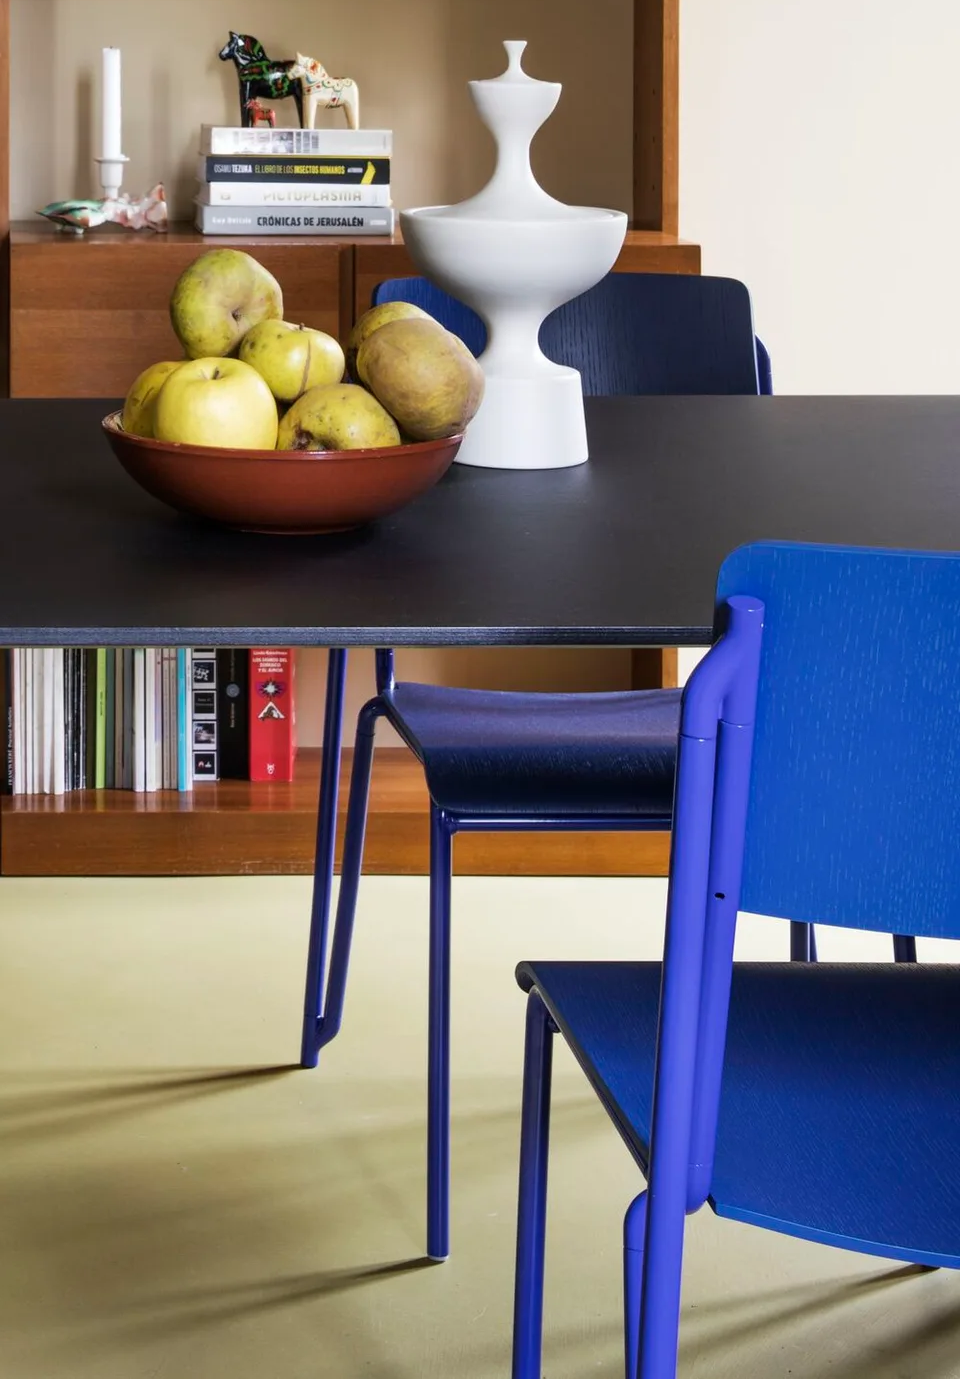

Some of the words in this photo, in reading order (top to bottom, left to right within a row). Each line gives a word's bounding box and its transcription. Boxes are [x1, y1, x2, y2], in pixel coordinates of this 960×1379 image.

[214, 165, 232, 173] OSAMU
[232, 164, 252, 173] TEZUKA
[255, 165, 261, 174] EL
[262, 165, 276, 174] LIBRO
[277, 166, 283, 174] DE
[283, 166, 293, 174] LOS
[294, 165, 319, 174] INSECTOS
[319, 166, 345, 174] HUMANOS
[257, 215, 301, 227] CRÓNICAS
[303, 217, 314, 227] DE
[316, 216, 364, 227] JERUSALÉN
